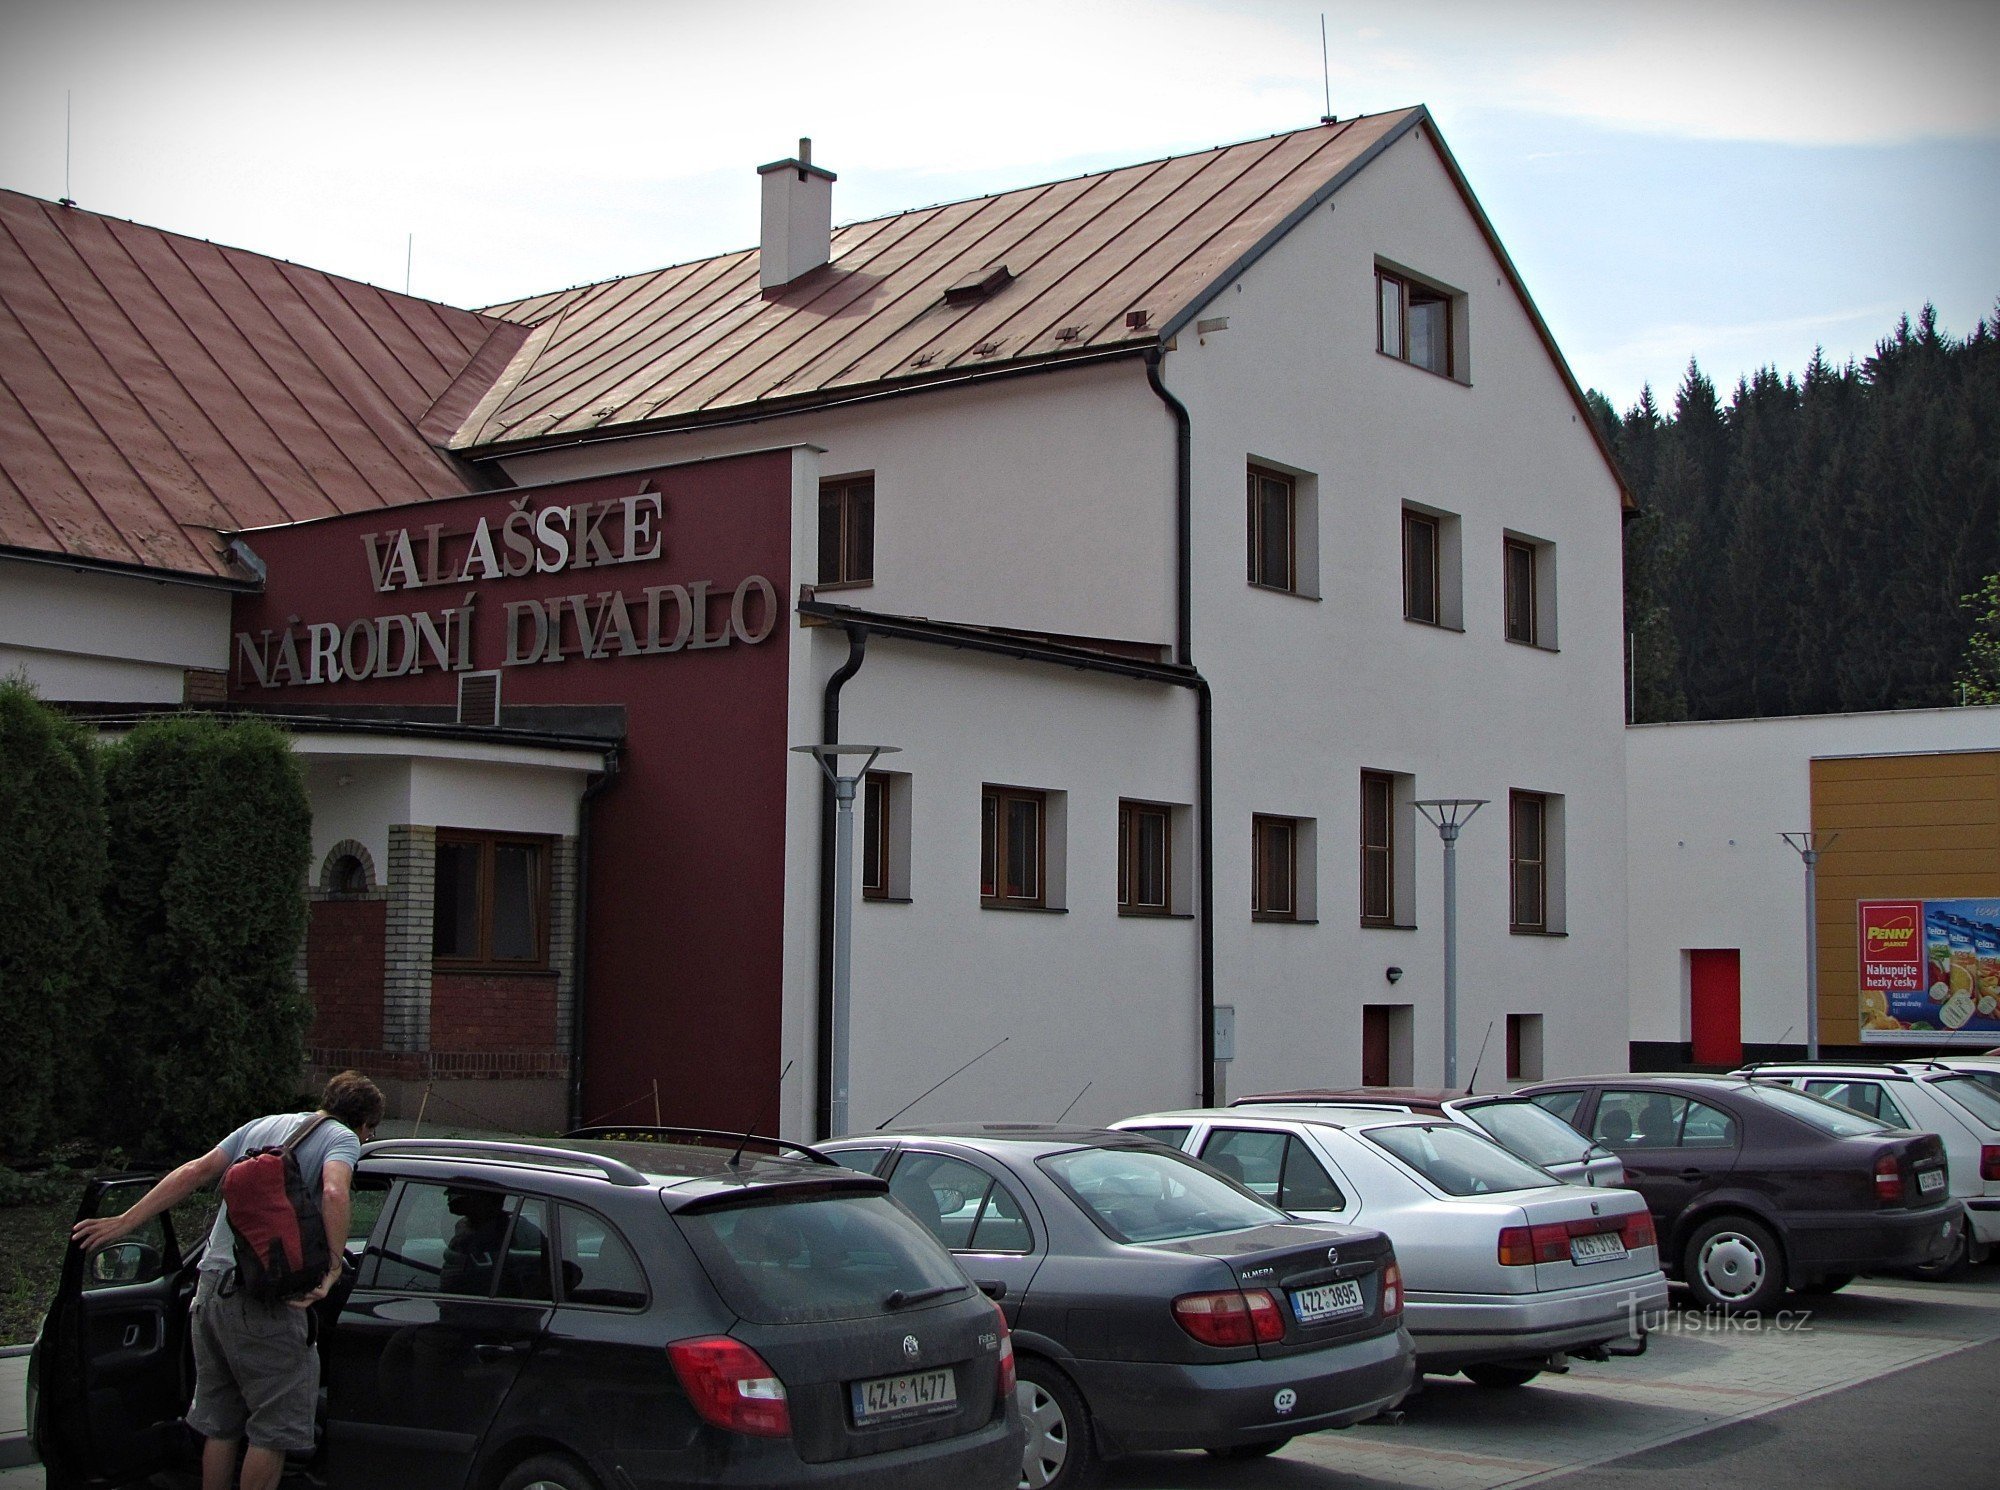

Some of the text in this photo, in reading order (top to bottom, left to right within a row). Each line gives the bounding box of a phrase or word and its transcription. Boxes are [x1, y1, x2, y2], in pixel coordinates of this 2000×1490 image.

[360, 479, 662, 592] VALAŠSKÉ
[236, 574, 777, 690] NÁRODNÍ DIVADLO
[1867, 927, 1914, 939] PENNY
[1866, 964, 1917, 977] Nakupujte
[1867, 977, 1917, 989] hezky česky
[1242, 1267, 1274, 1280] ALMERA
[1301, 1290, 1324, 1313] 4Z2
[1328, 1284, 1358, 1308] 3895
[868, 1373, 946, 1411] 4Z4 1477
[1279, 1394, 1292, 1405] CZ
